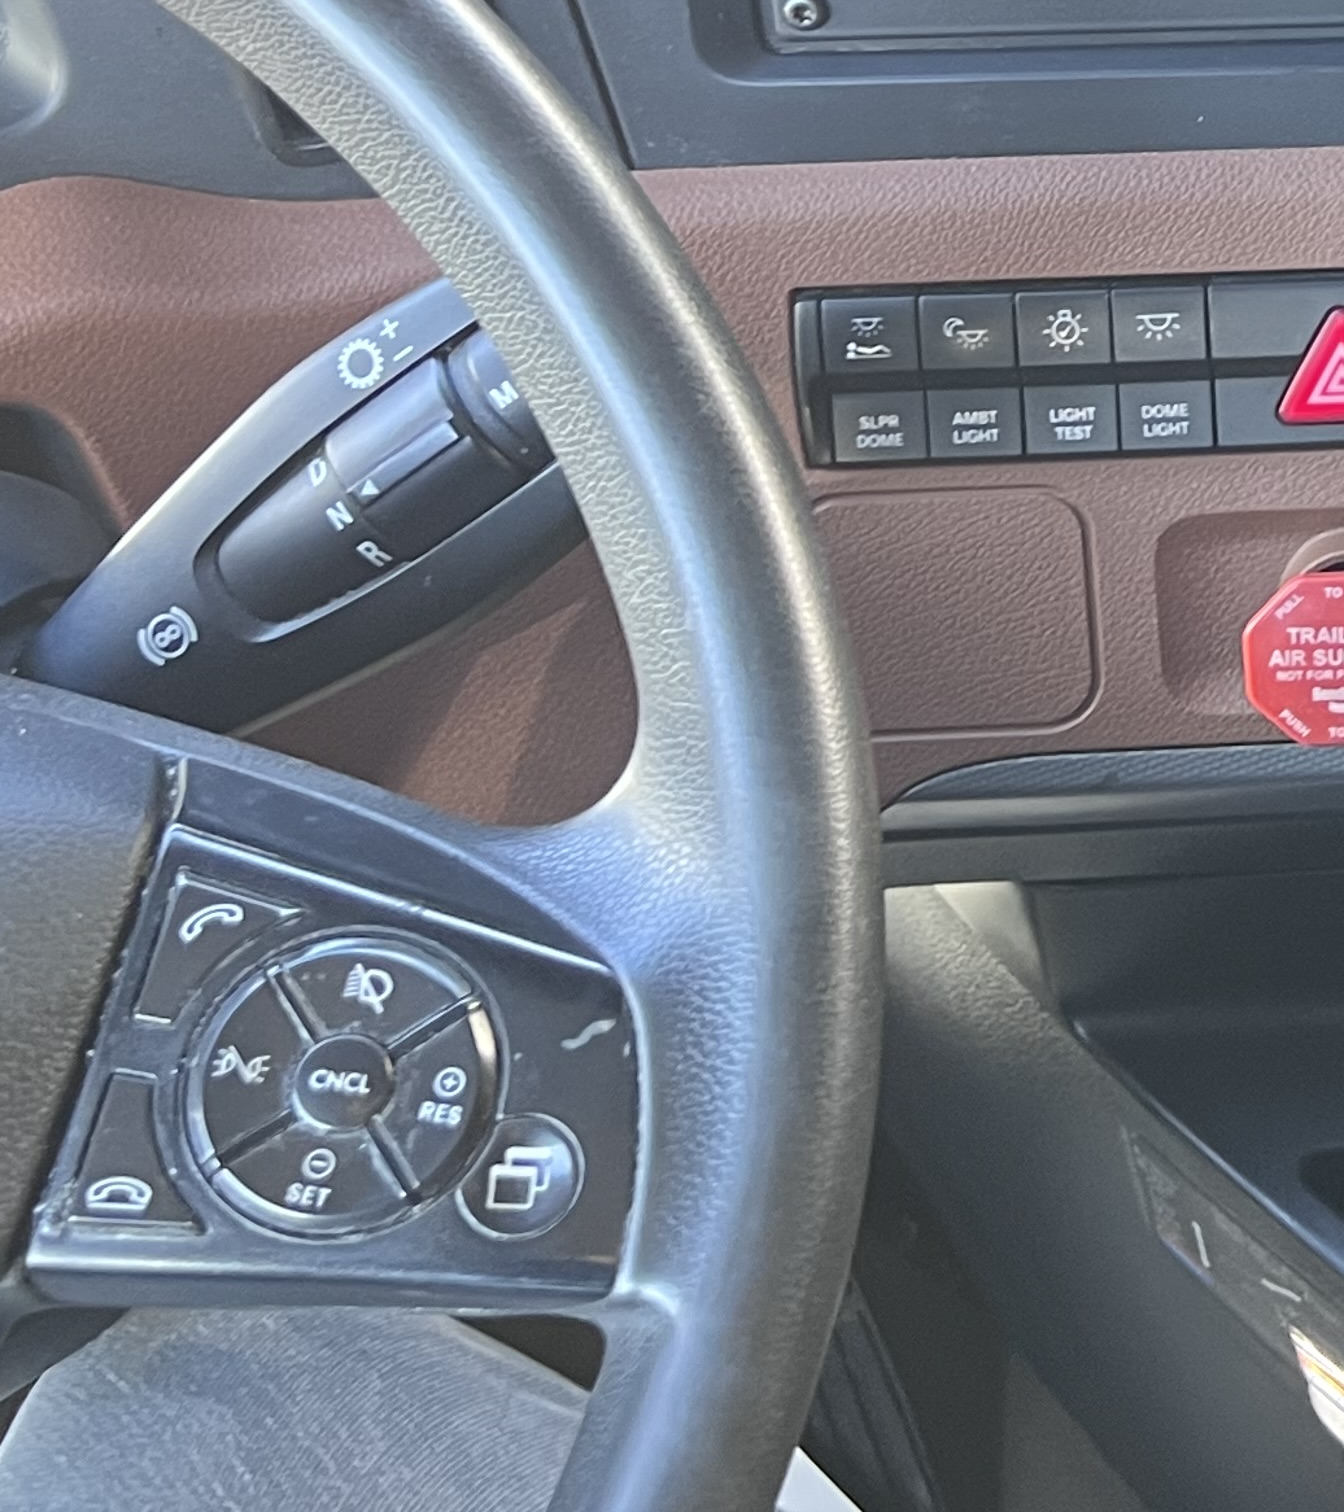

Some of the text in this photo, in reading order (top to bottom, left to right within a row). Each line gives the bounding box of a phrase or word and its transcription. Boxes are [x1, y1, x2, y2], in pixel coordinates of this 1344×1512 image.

[488, 379, 521, 409] M
[952, 409, 999, 427] AMBT
[1049, 406, 1096, 424] LIGHT
[1140, 402, 1189, 420] DOME
[858, 414, 899, 431] SLPR
[1143, 420, 1190, 438] LIGHT
[856, 432, 904, 449] DOME
[953, 427, 999, 445] LIGHT
[1054, 424, 1093, 441] TEST
[325, 501, 355, 532] N
[355, 538, 394, 568] R
[1273, 594, 1305, 620] PULL
[1323, 586, 1344, 599] TO
[1268, 648, 1307, 668] AIR
[1275, 670, 1304, 681] NOT
[1306, 669, 1333, 681] FOR
[1278, 708, 1312, 738] PUSH
[306, 1067, 372, 1095] CNCL
[416, 1100, 464, 1127] RES
[283, 1181, 333, 1208] SET
